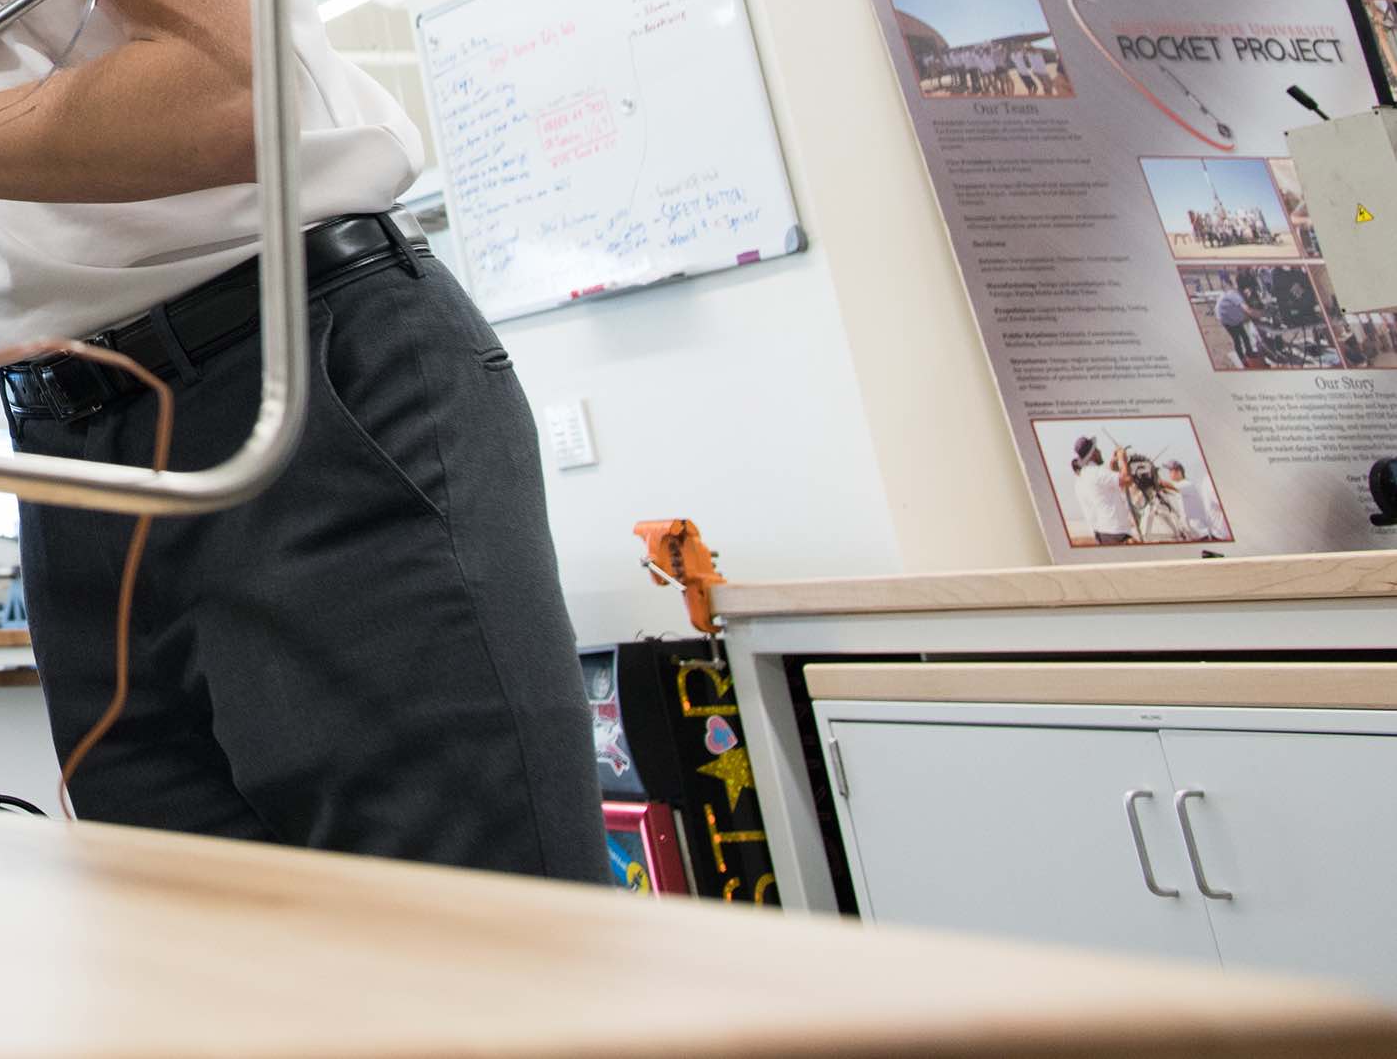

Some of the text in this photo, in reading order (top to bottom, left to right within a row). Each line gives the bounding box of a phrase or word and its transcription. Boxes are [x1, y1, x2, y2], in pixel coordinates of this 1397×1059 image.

[1116, 35, 1345, 63] ROCKET PROJECT
[973, 102, 1040, 116] Our Team
[1314, 376, 1375, 391] Our Story
